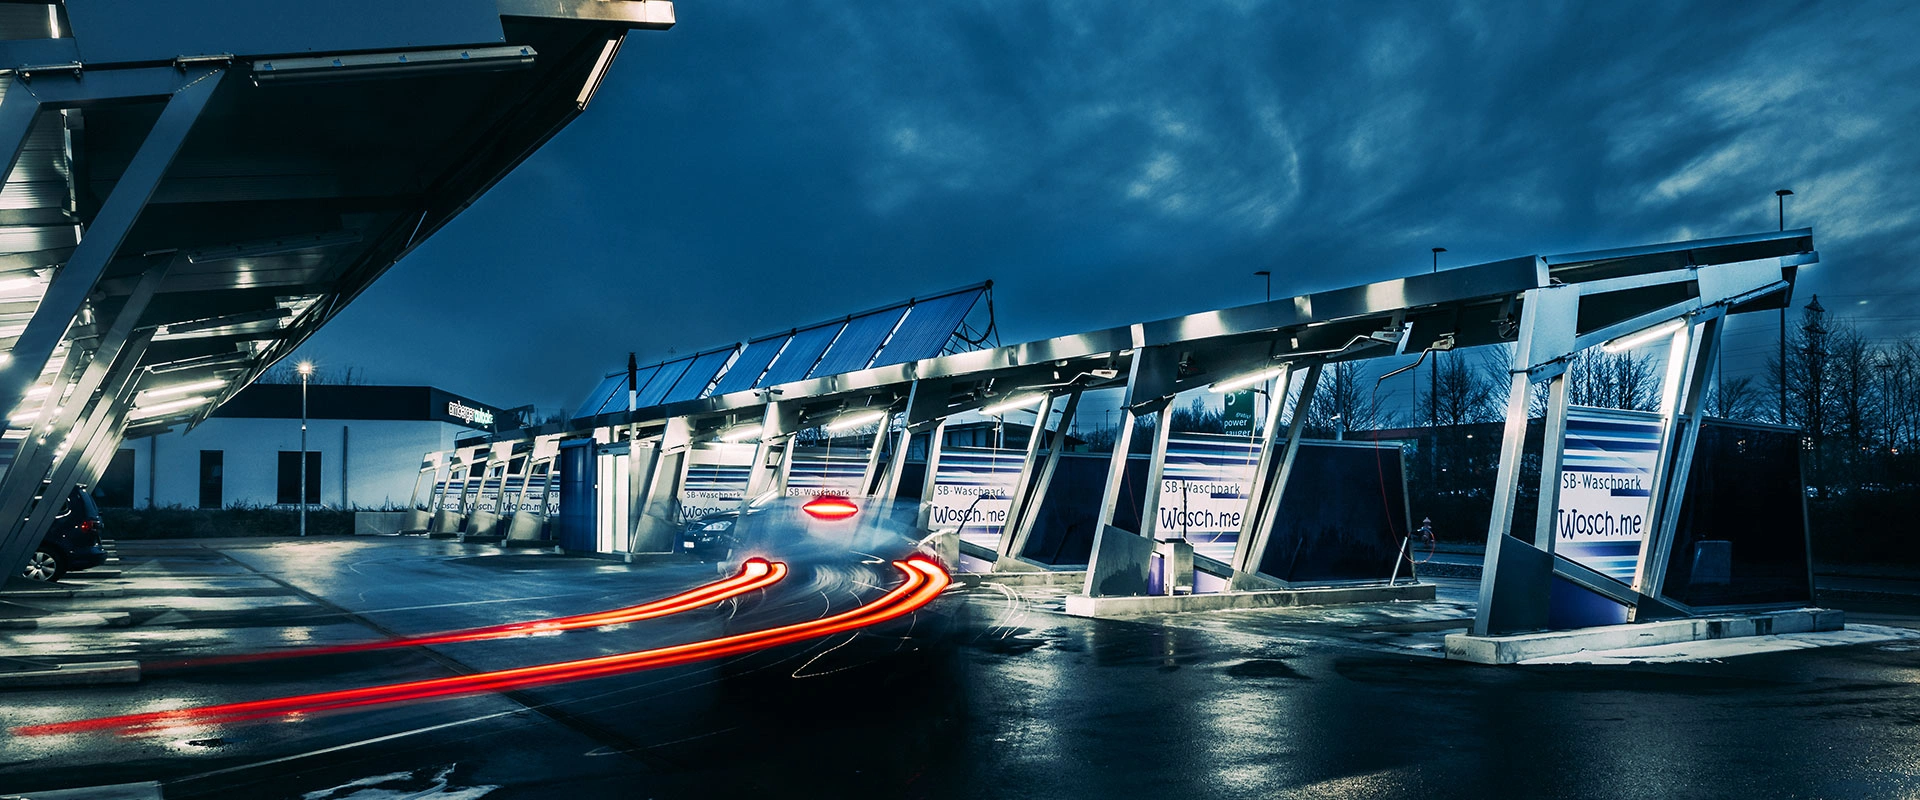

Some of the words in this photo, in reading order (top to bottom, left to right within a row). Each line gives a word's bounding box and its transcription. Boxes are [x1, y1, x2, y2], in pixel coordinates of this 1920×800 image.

[1224, 420, 1247, 429] power
[1165, 481, 1241, 494] SB-Waschpark
[1563, 473, 1641, 490] SB-Waschpark
[686, 491, 741, 499] SB-Waschpark
[937, 486, 1006, 496] SB-Waschpark
[933, 506, 1005, 524] Wosch.me
[1160, 507, 1241, 530] Wosch.me
[1558, 509, 1642, 540] Wosch.me
